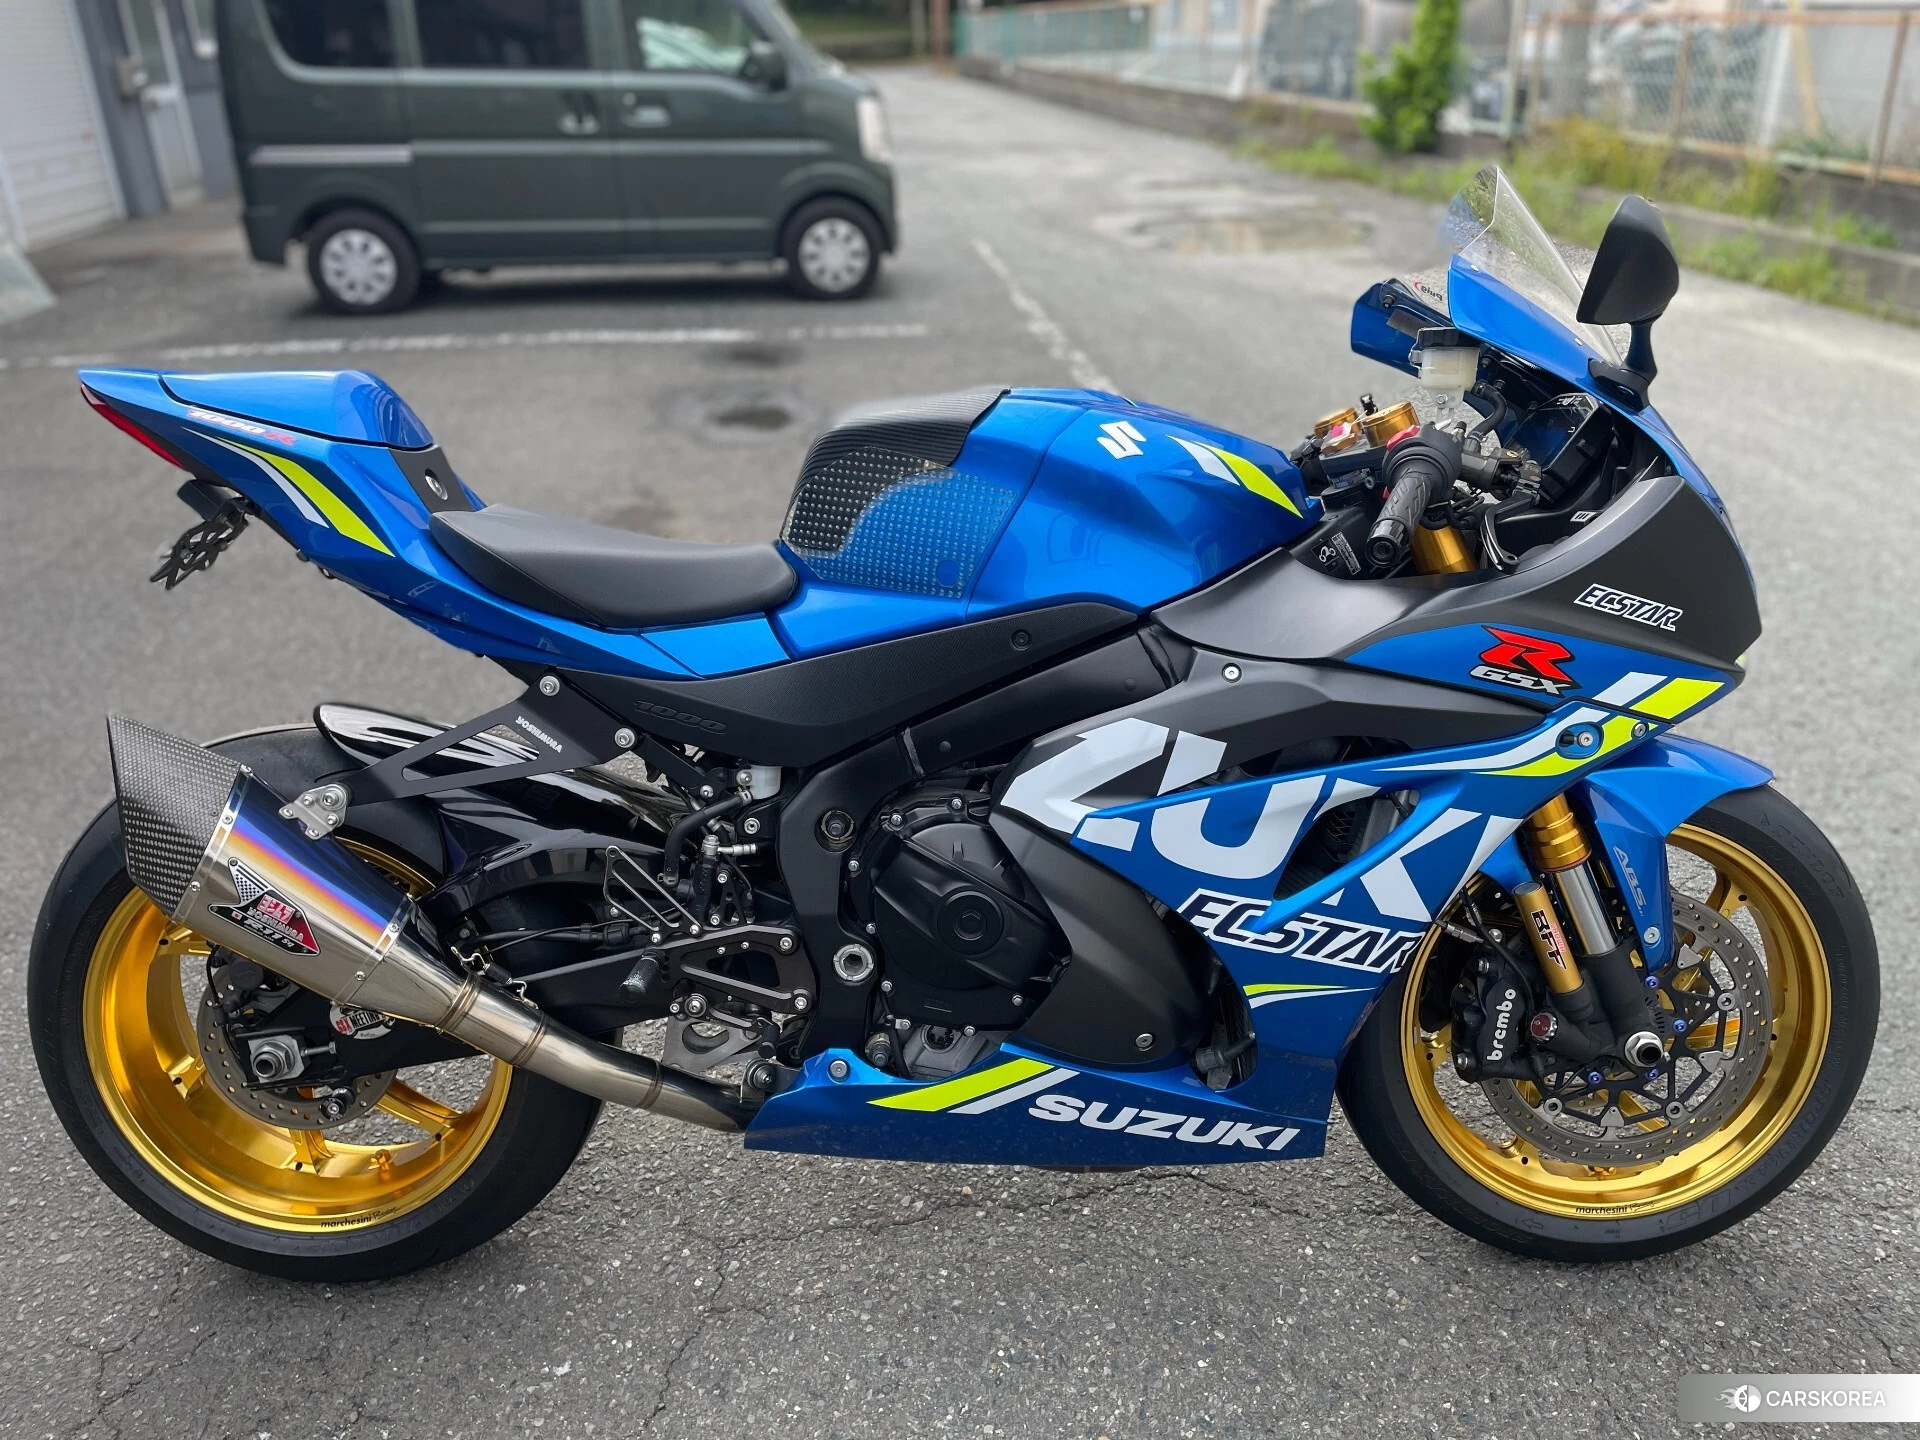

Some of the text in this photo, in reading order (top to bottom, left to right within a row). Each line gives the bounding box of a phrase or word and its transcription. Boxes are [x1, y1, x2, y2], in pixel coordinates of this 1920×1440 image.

[187, 409, 265, 434] 1000
[1574, 583, 1683, 632] ECSTAR
[1469, 664, 1571, 695] GSX
[514, 715, 563, 753] YOSHIMURA
[633, 700, 729, 735] 1000
[1613, 845, 1647, 912] ABS
[246, 906, 305, 942] YOSHIMURA
[1486, 988, 1517, 1062] brembo
[1028, 1094, 1301, 1151] SUZUKI
[320, 1214, 372, 1228] marchesini
[1575, 1204, 1628, 1214] marchesini
